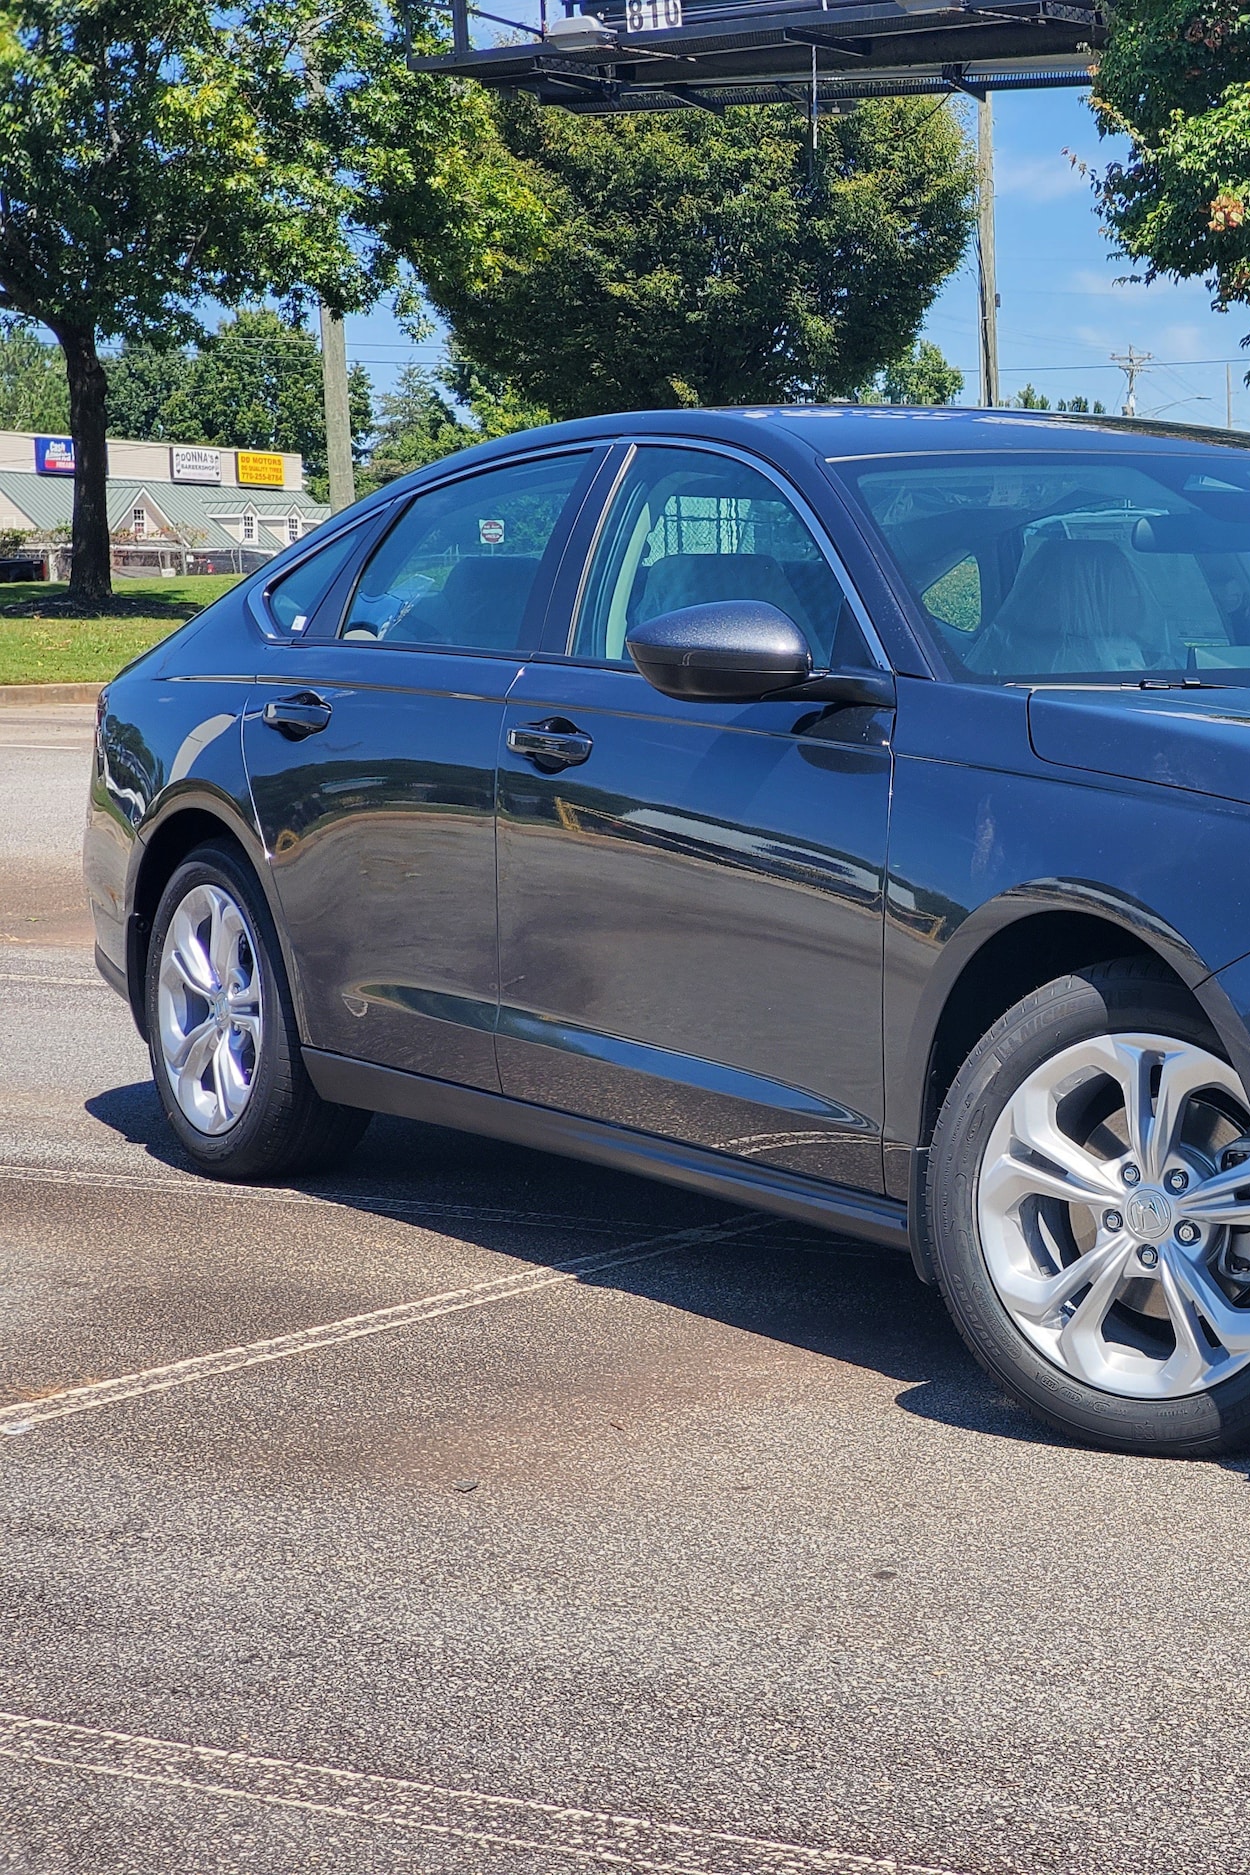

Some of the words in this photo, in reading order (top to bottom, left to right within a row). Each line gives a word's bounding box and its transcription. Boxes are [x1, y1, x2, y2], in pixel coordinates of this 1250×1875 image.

[629, 0, 679, 30] 810
[181, 451, 214, 463] DONNA'S
[252, 457, 282, 466] MOTORS
